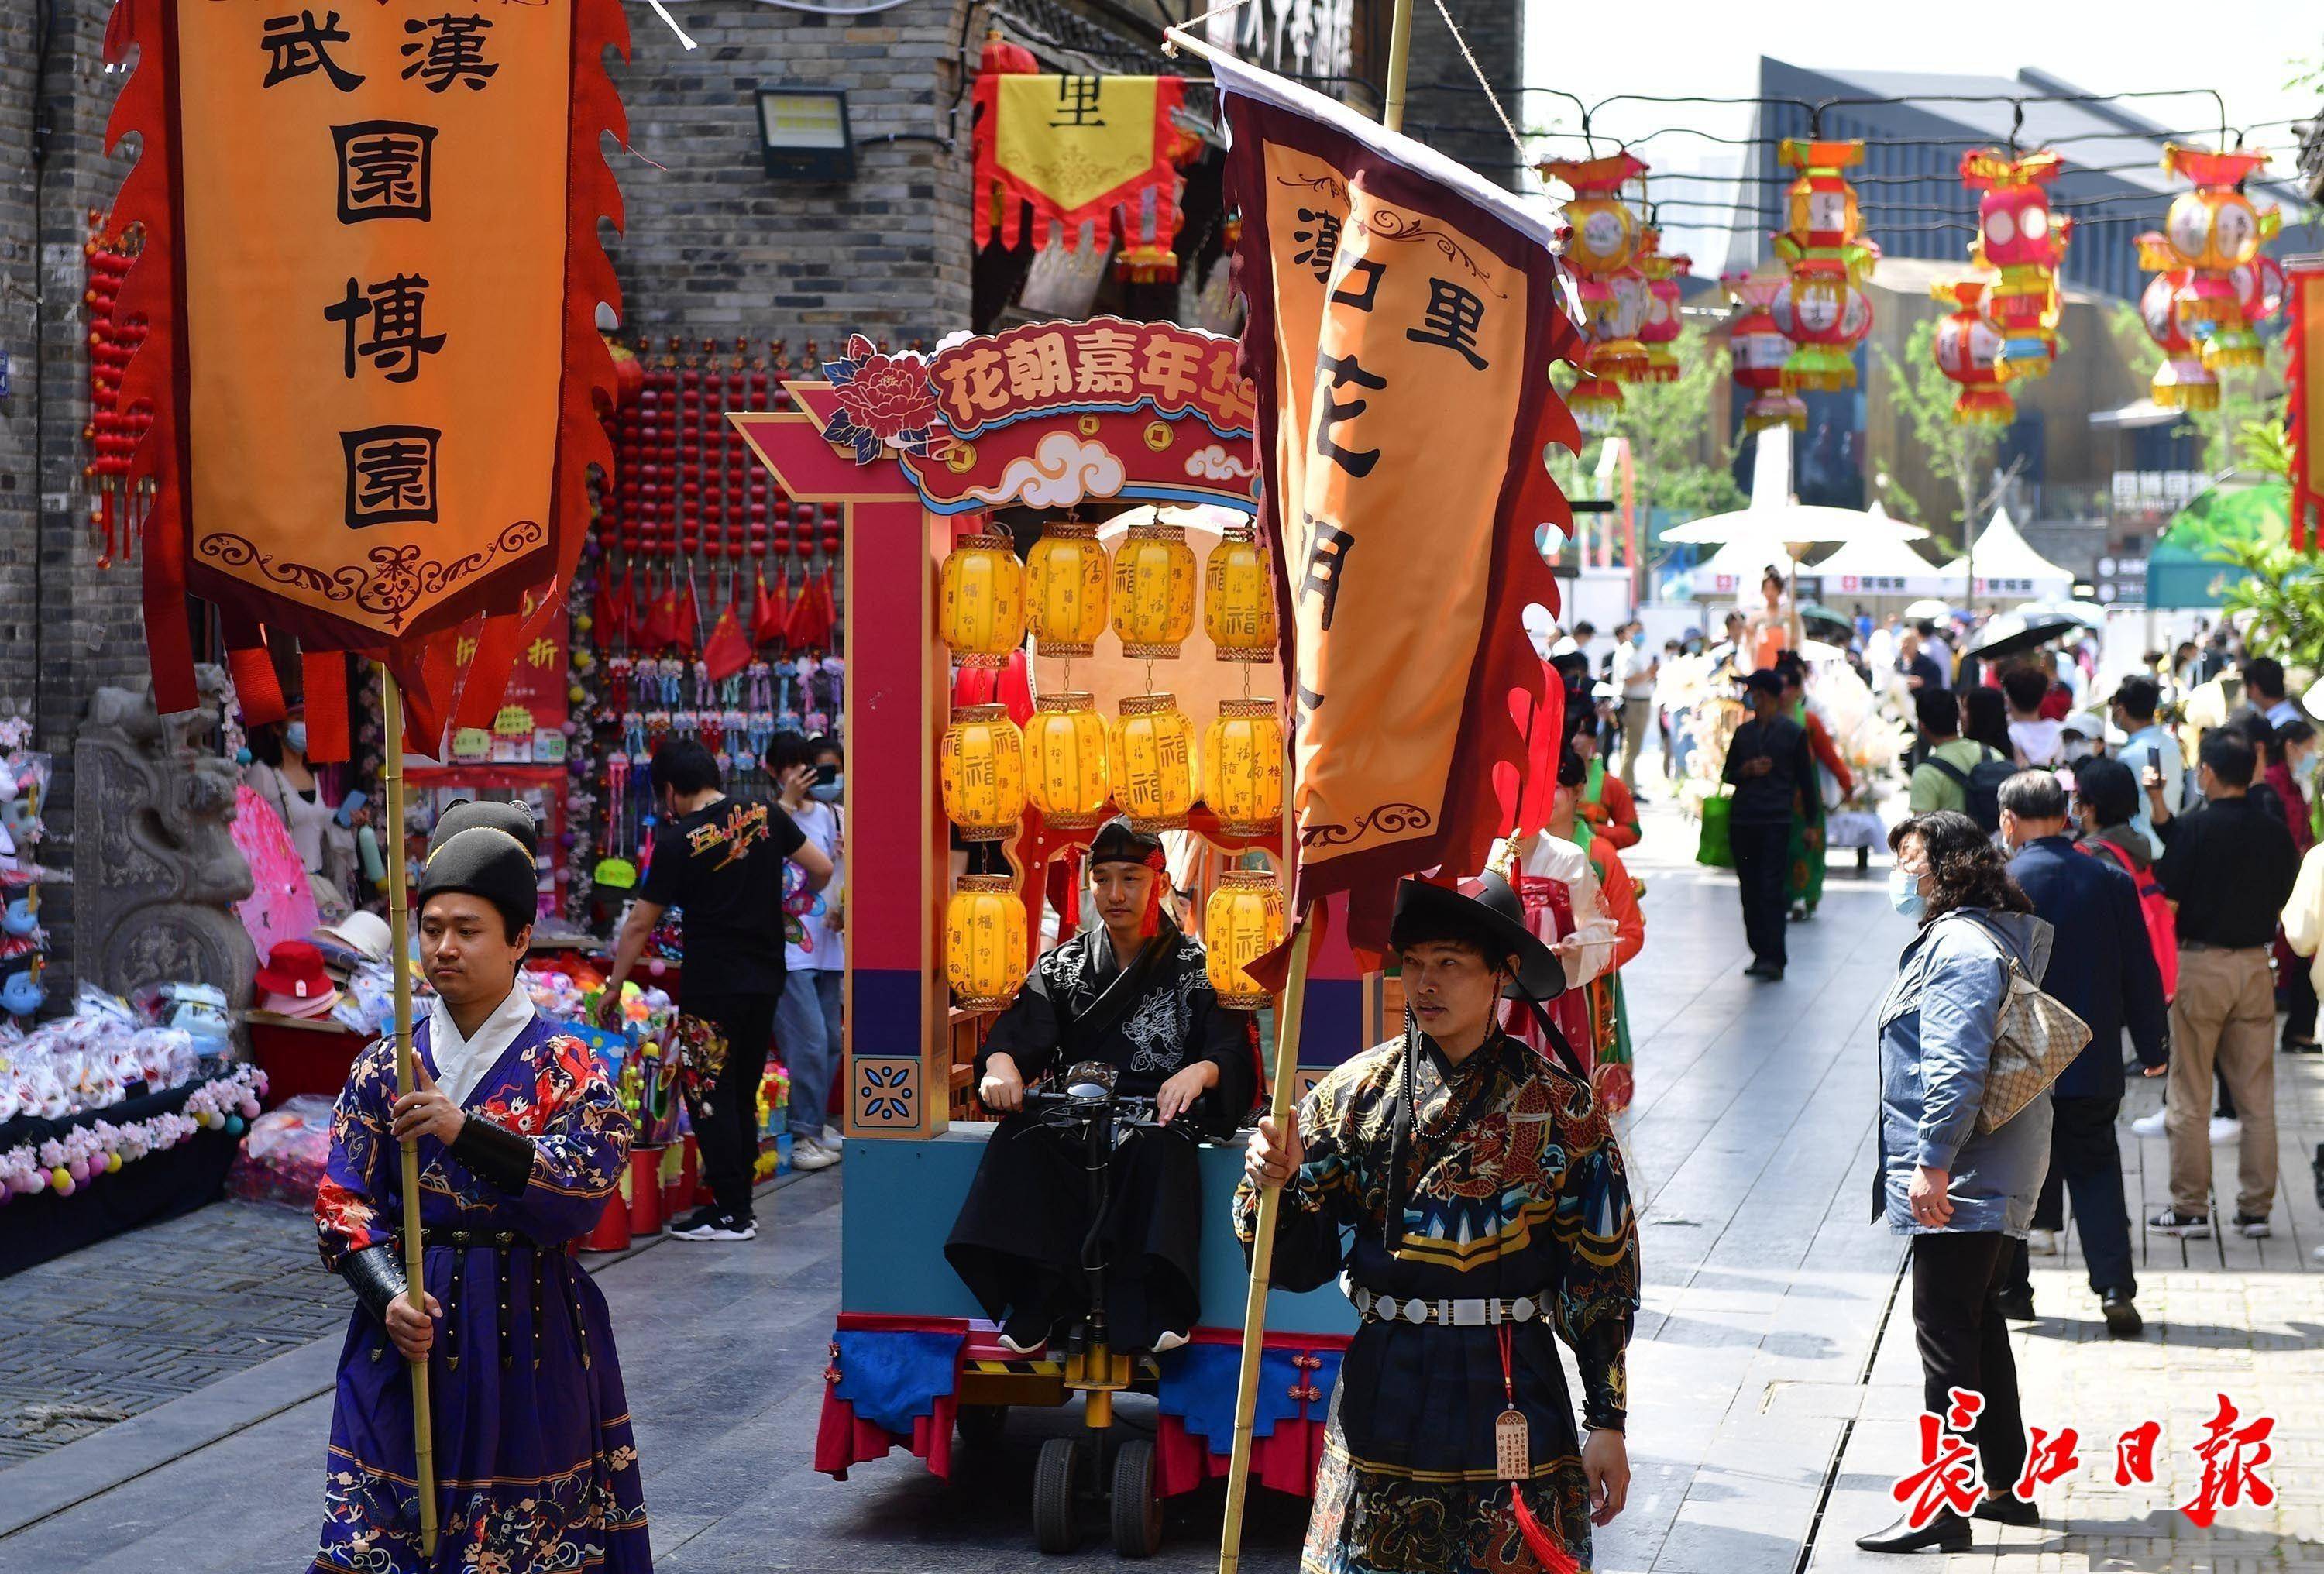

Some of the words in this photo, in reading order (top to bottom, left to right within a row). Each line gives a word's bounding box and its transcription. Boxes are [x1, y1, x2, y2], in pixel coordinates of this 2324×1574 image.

[261, 9, 500, 93] 武漢
[324, 120, 447, 530] 園博園
